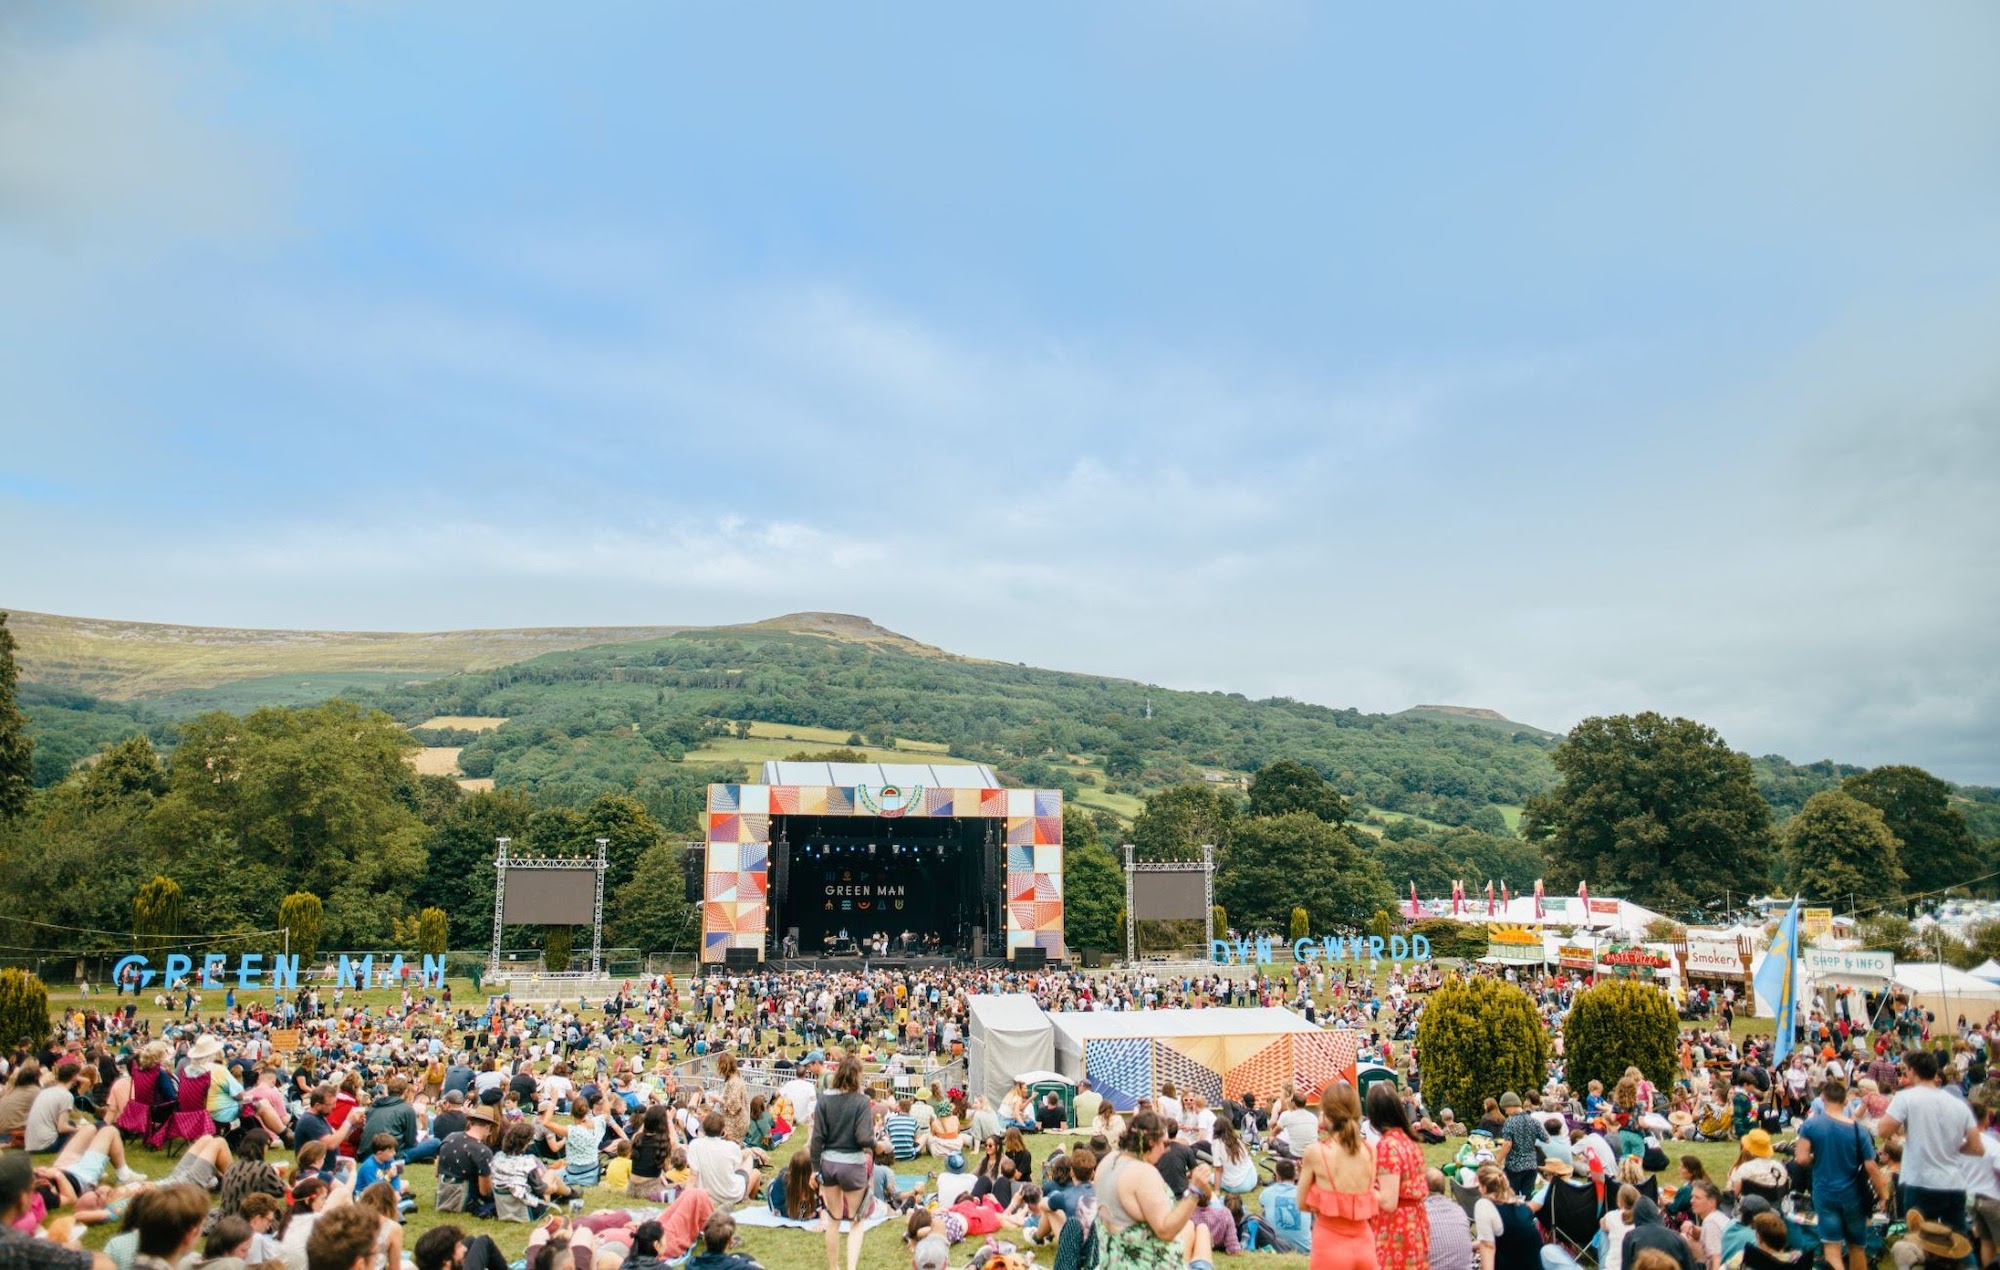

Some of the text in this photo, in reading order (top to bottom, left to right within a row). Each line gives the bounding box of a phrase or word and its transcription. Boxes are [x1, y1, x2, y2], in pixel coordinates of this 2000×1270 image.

[825, 885, 905, 896] GREEN MAN
[1212, 934, 1431, 967] DYN GWYRDD
[1605, 951, 1630, 964] PASTA
[1634, 954, 1659, 966] PIZZA
[1692, 952, 1738, 968] Smokery
[1812, 956, 1884, 970] SHOP & INFO
[113, 953, 446, 991] GREEN MAN
